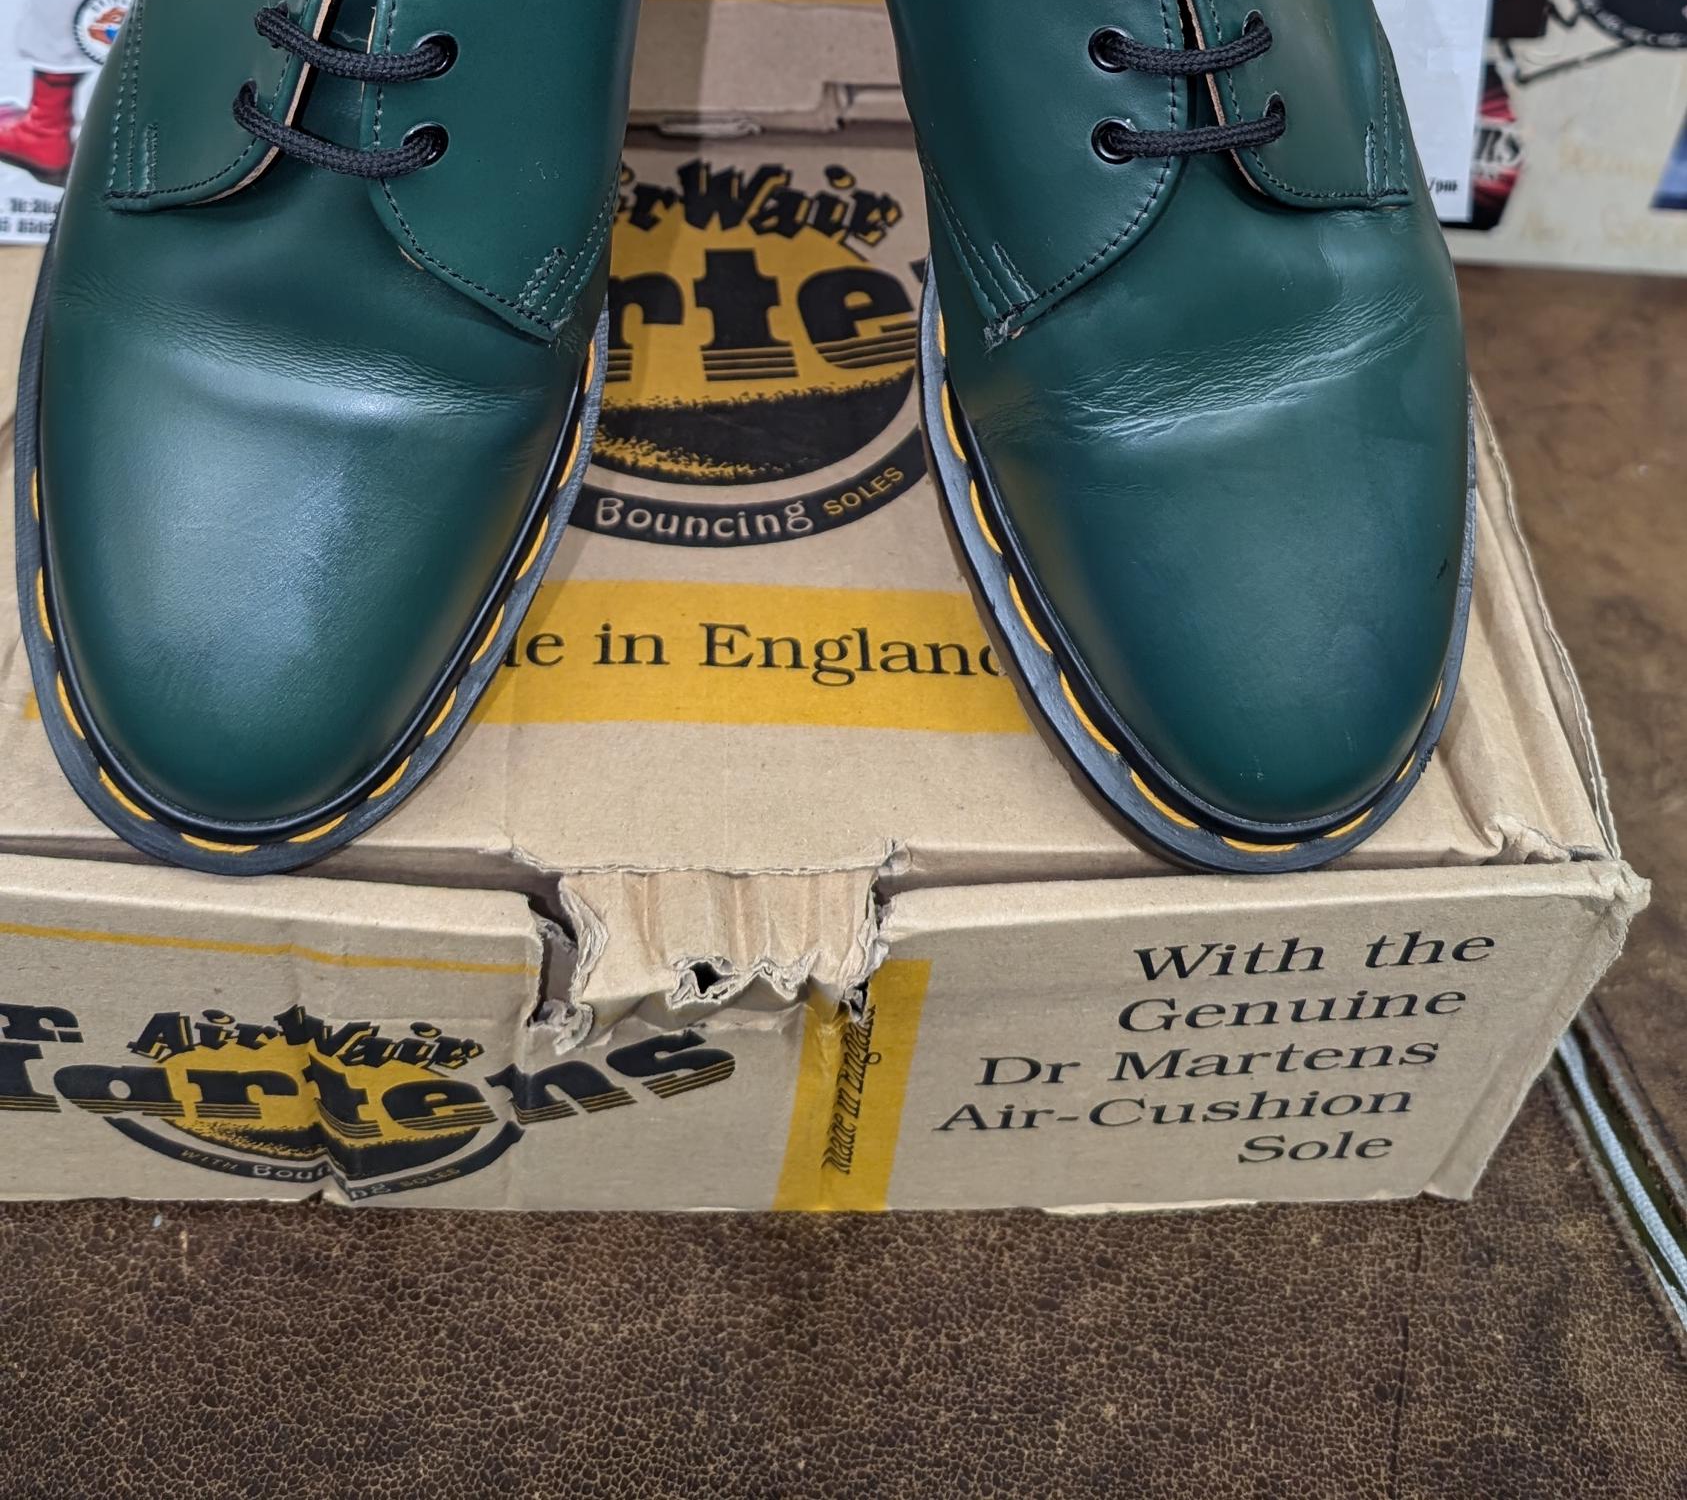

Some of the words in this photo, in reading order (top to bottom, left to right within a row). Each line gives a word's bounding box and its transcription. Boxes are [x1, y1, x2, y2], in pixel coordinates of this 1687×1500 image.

[594, 496, 815, 538] Bouncing
[823, 465, 904, 518] SOLES
[592, 622, 671, 666] in
[1133, 937, 1326, 982] With
[1364, 931, 1496, 968] the
[1118, 990, 1467, 1033] Genuine
[126, 1004, 484, 1070] AirWair
[974, 1056, 1082, 1086] Dr
[1107, 1041, 1440, 1082] Martens
[931, 1090, 1413, 1133] Air-Cushion
[1236, 1130, 1395, 1164] Sole
